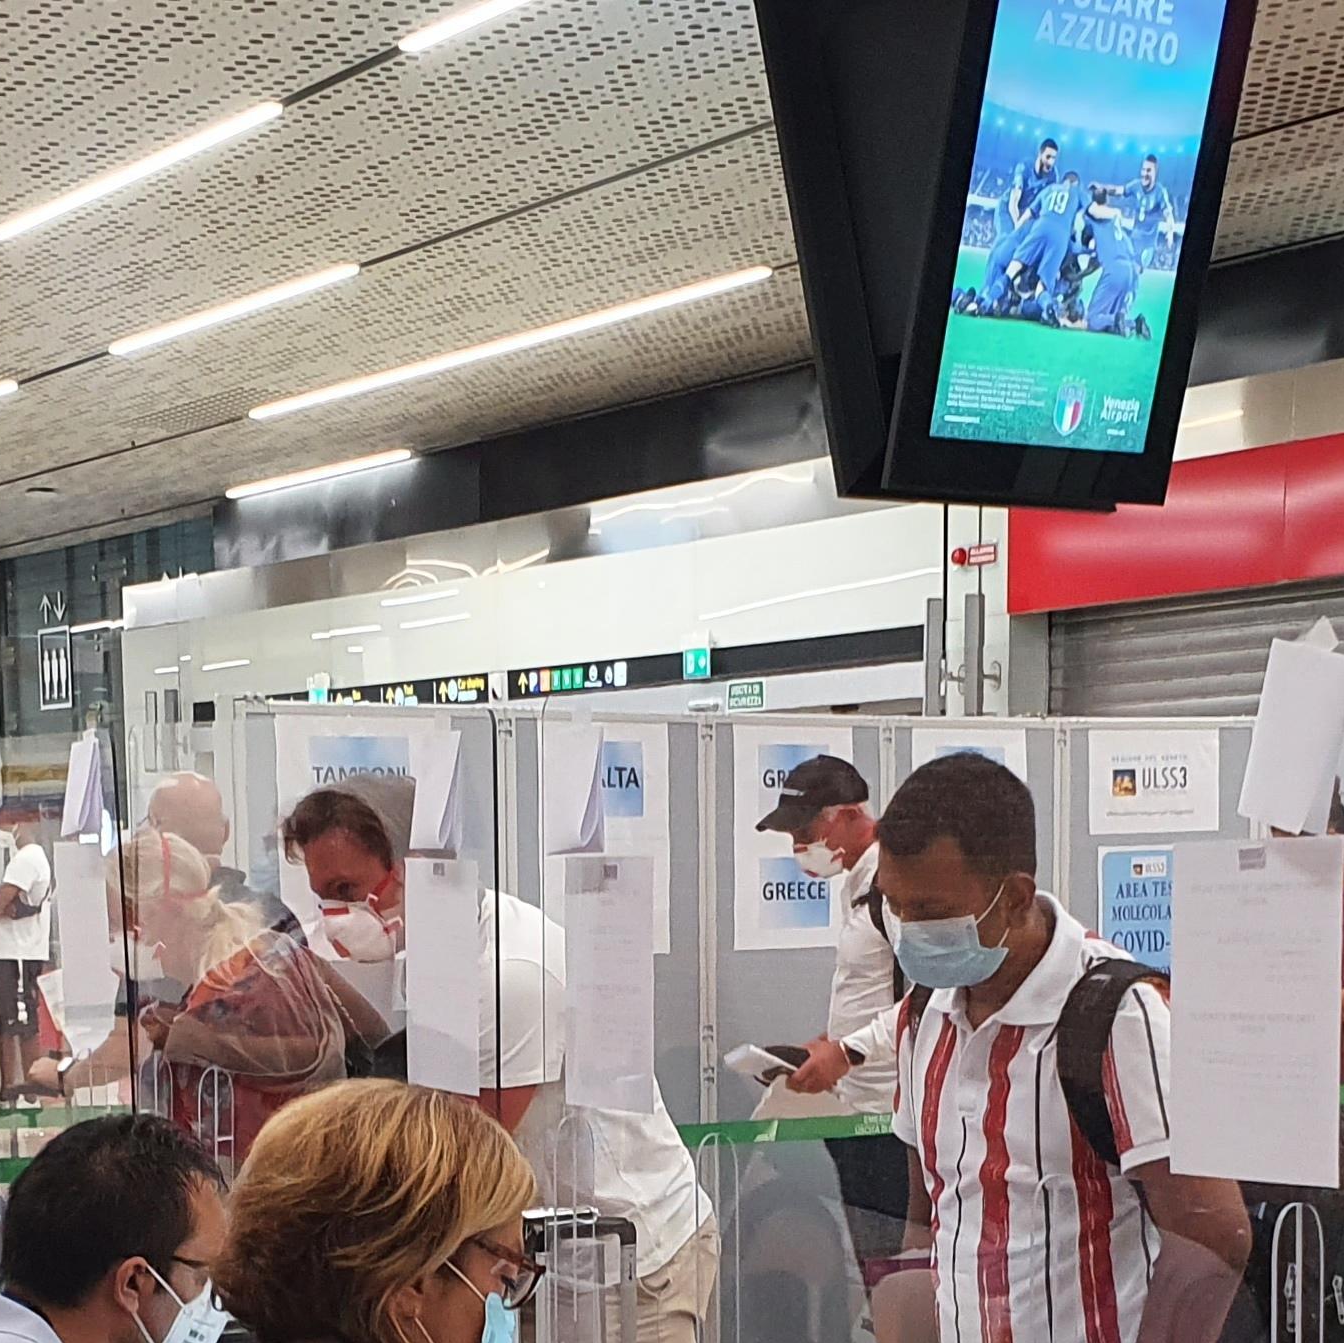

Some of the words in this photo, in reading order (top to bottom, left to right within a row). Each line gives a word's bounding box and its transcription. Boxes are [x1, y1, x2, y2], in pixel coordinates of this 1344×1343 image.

[1058, 0, 1174, 26] ARE
[1034, 8, 1179, 66] AZZURRO
[1102, 395, 1141, 411] Venezia
[1100, 407, 1139, 424] Airport
[601, 766, 640, 789] LTA
[1142, 766, 1187, 789] ULSS3
[763, 881, 827, 901] GREECE
[1116, 881, 1147, 899] AREA
